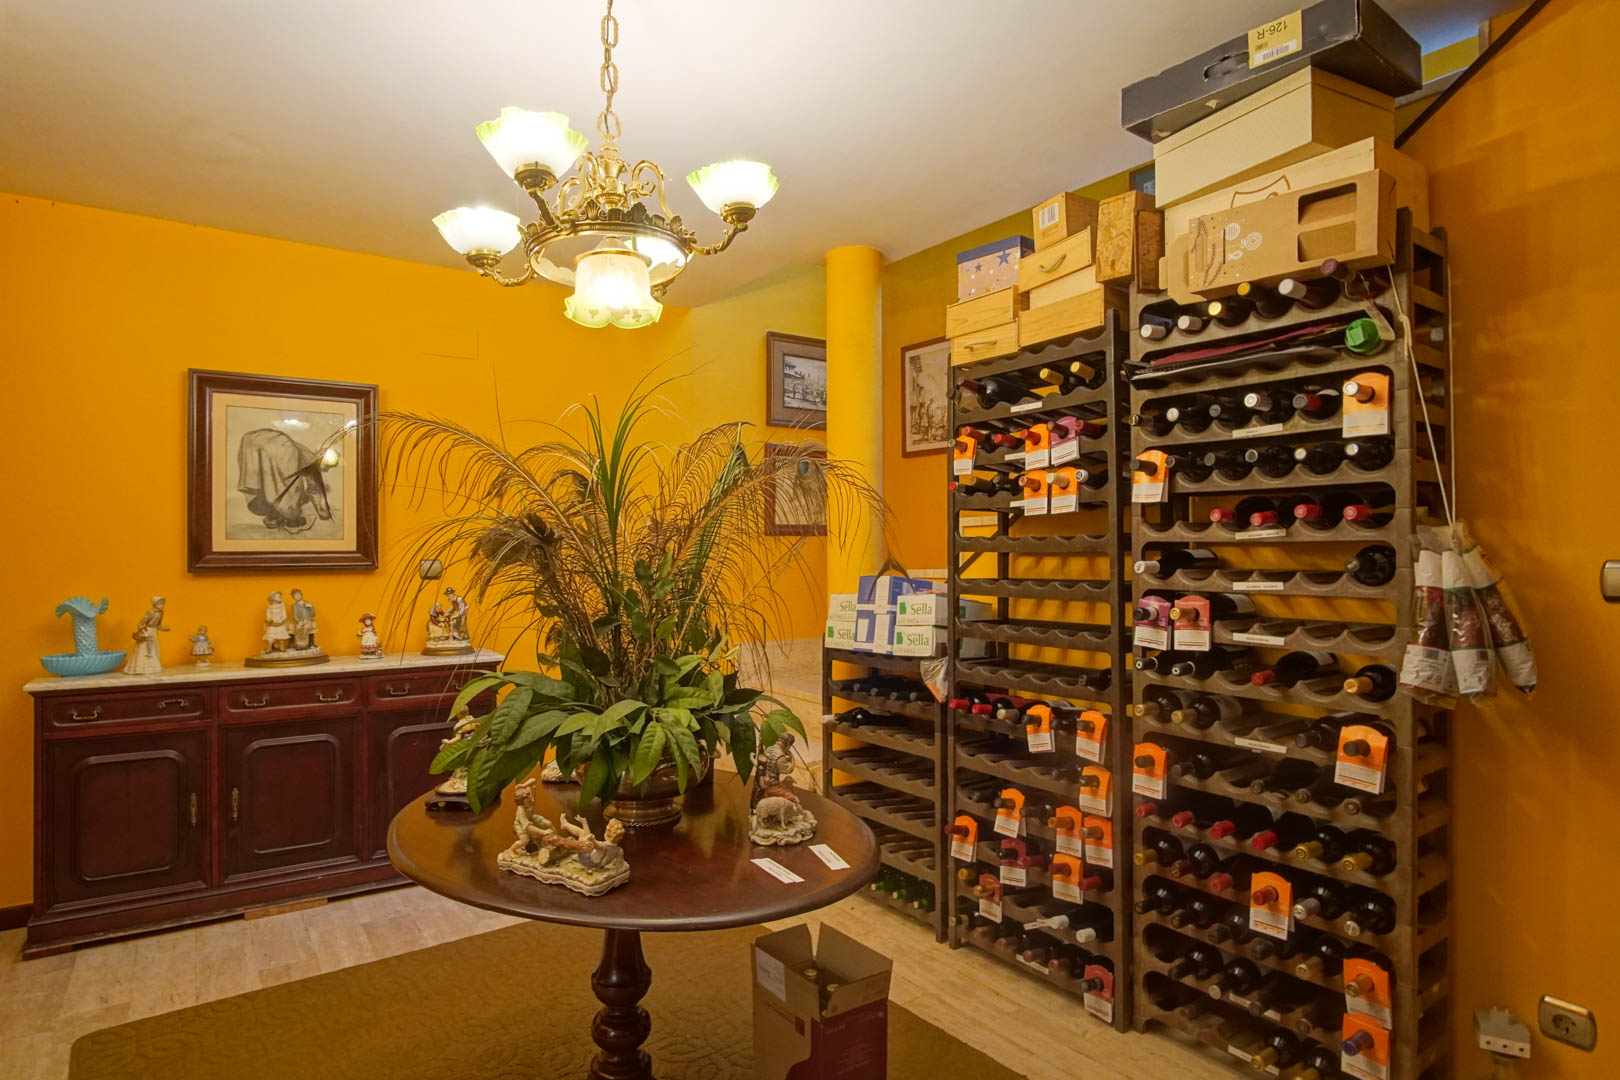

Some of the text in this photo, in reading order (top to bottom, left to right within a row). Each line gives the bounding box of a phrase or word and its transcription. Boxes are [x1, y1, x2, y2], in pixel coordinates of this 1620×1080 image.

[1256, 20, 1288, 40] 126-R
[910, 602, 932, 616] Sella
[906, 633, 930, 646] Sella
